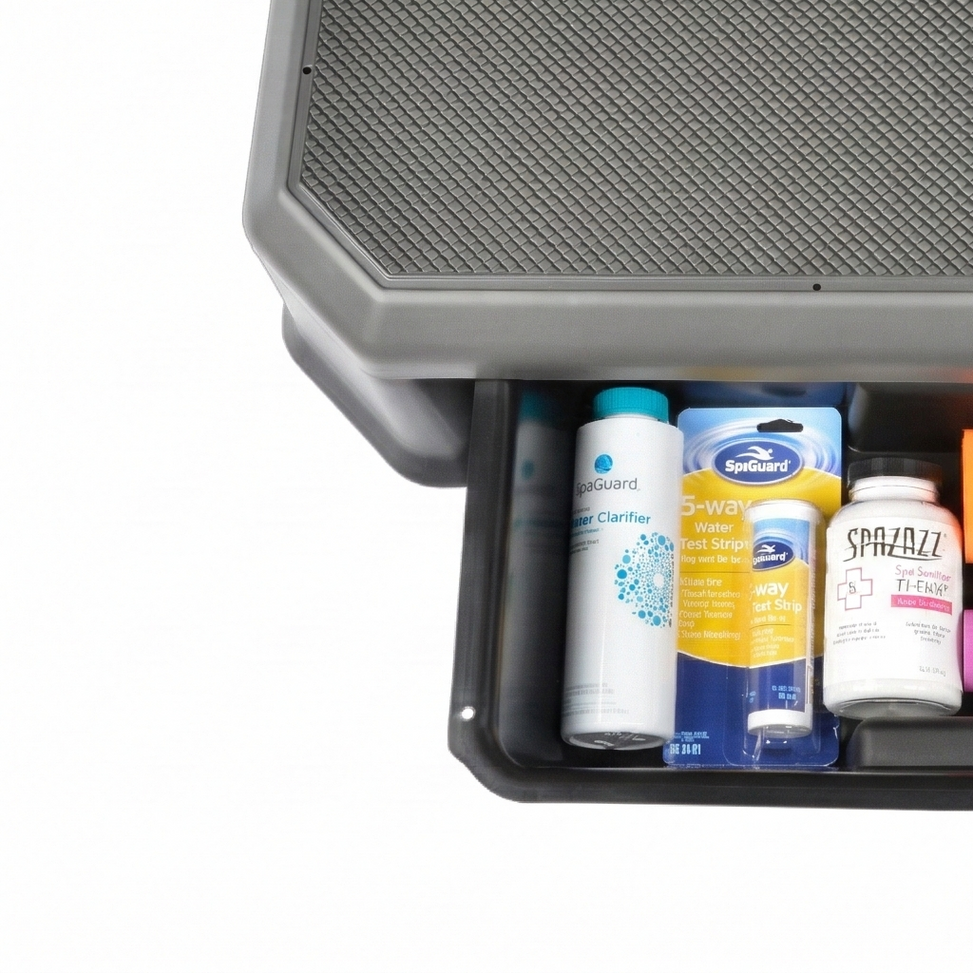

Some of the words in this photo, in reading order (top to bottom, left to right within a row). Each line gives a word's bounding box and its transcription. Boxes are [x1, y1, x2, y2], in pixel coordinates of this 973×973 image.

[576, 477, 638, 498] SpaGuard
[682, 495, 752, 521] 5-way
[572, 515, 594, 528] ater
[597, 511, 651, 525] Clarifier
[695, 522, 734, 533] Water
[680, 538, 708, 550] Test
[711, 537, 749, 553] Strip
[774, 598, 803, 614] Strip
